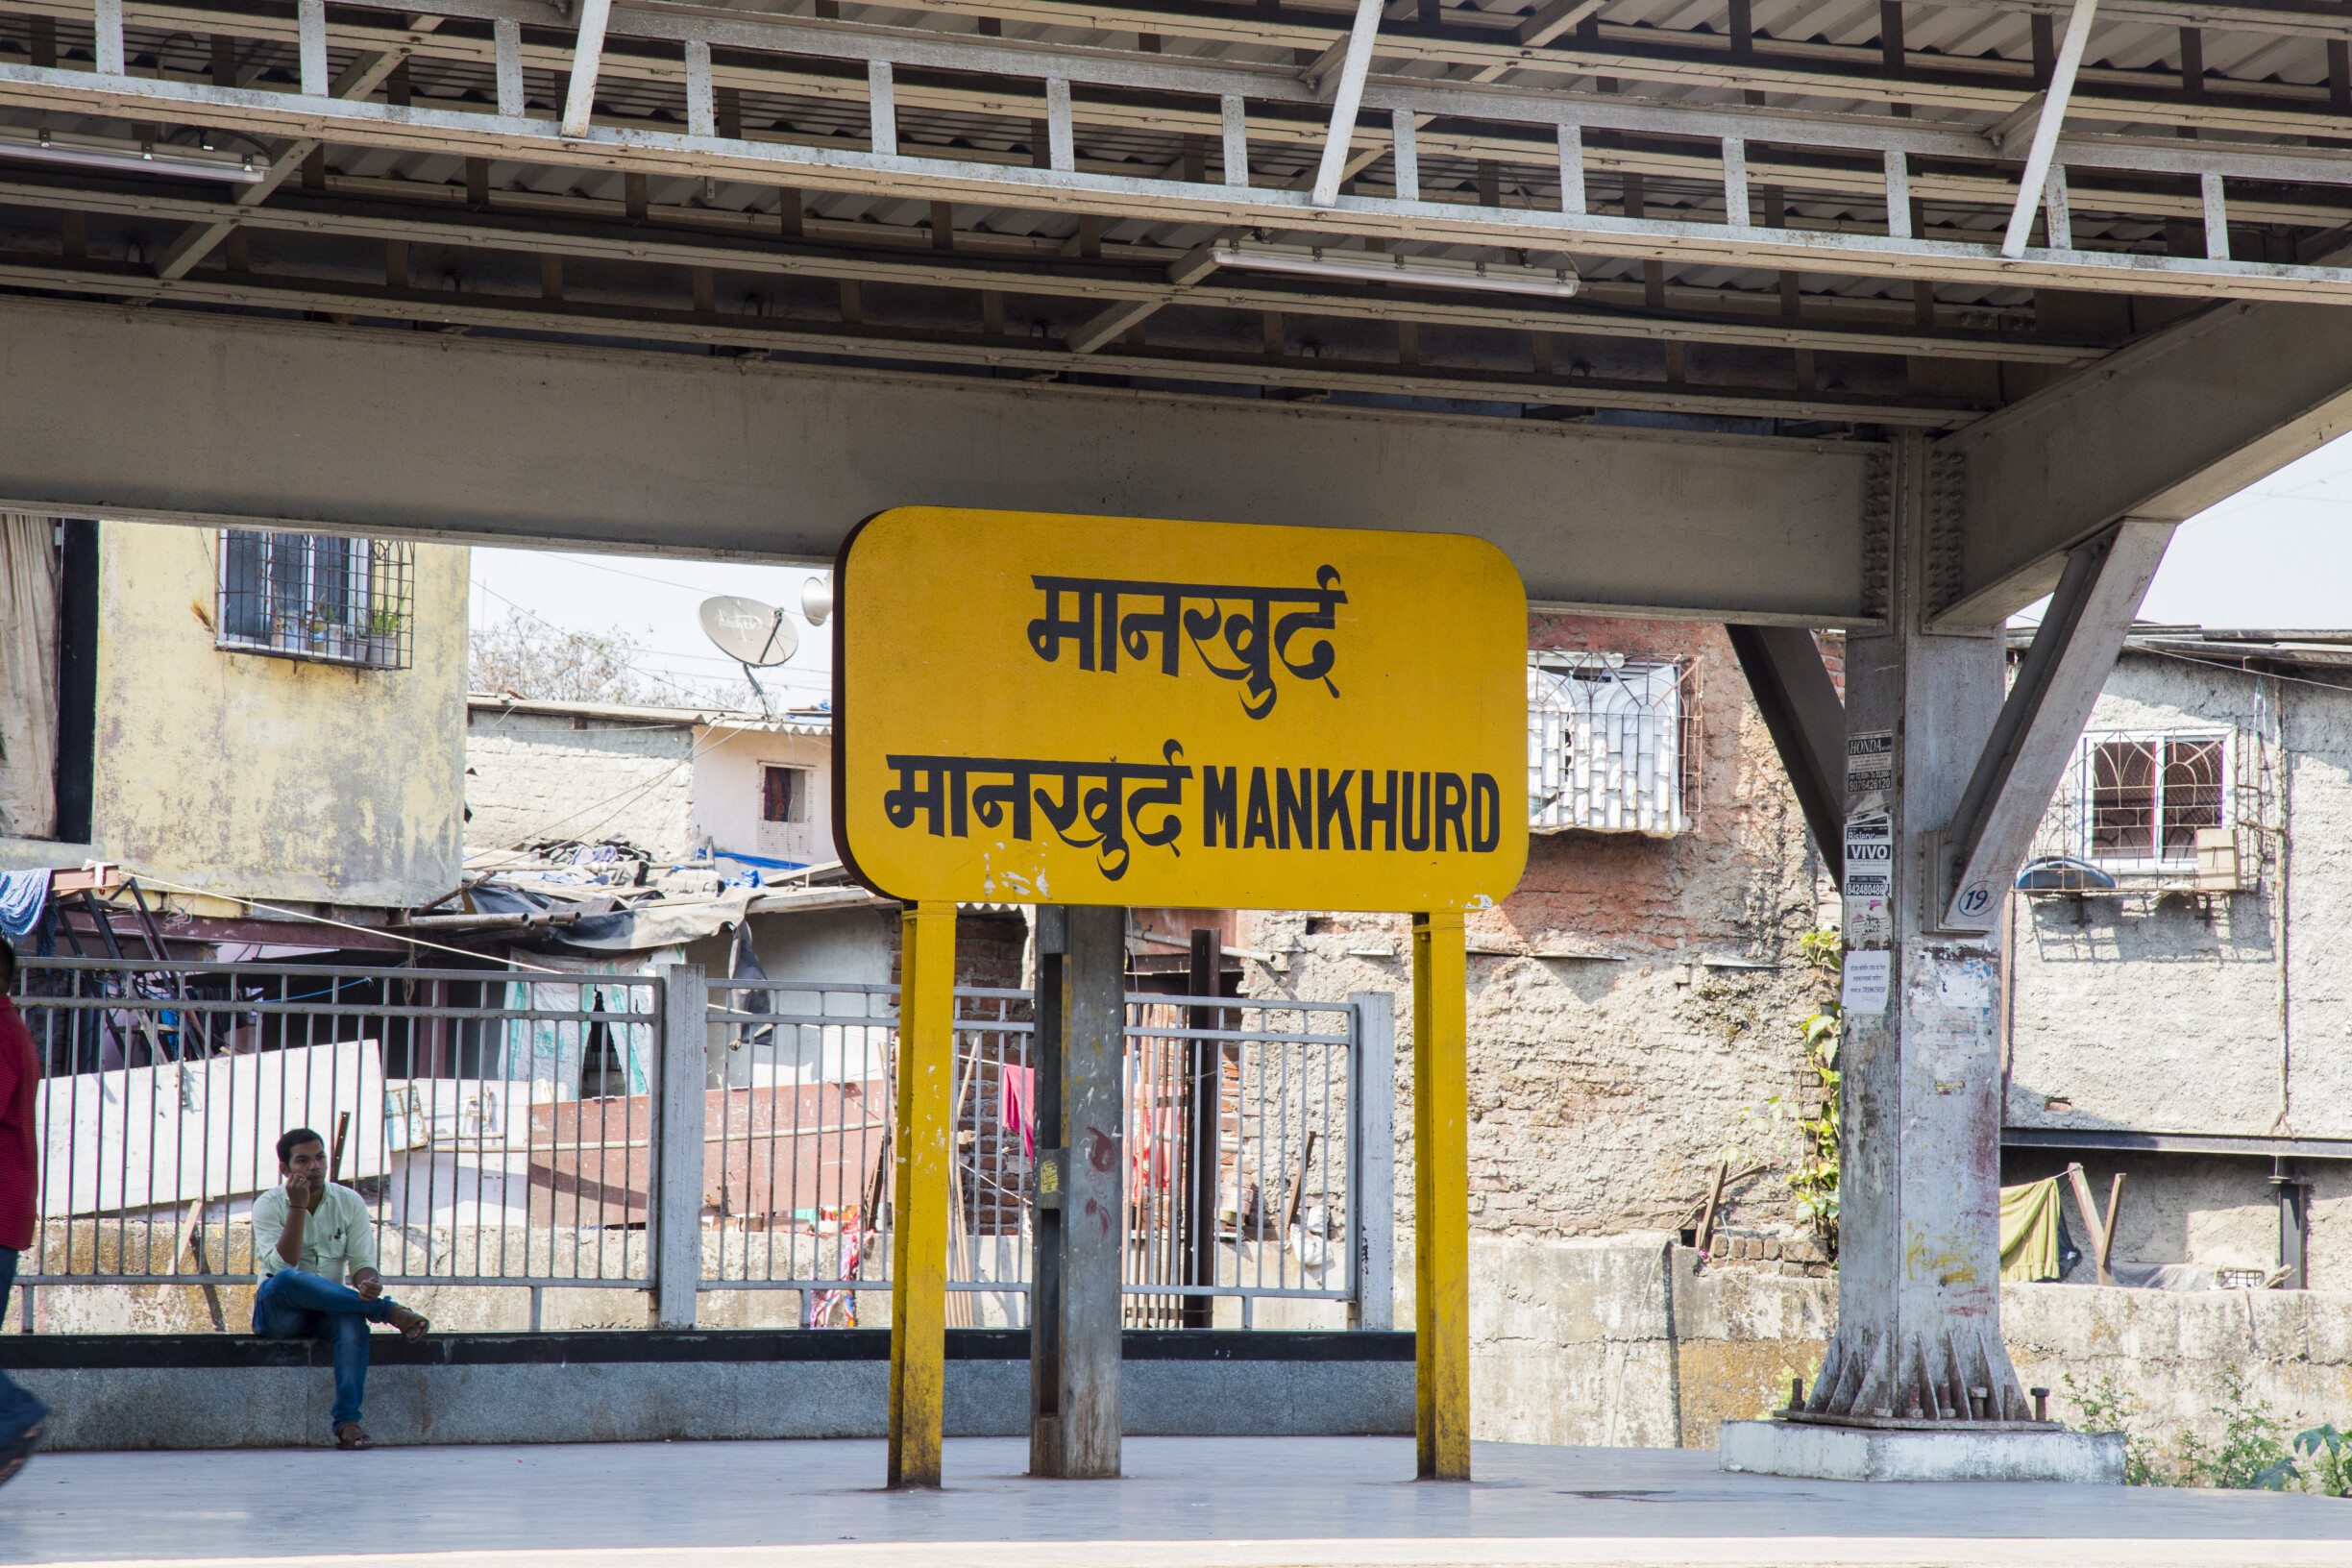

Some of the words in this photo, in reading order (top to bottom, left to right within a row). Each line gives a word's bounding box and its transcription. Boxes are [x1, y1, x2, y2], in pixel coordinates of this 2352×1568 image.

[1027, 564, 1347, 721] मानखुर्द
[1850, 739, 1881, 754] HONDA
[1850, 778, 1891, 792] 9076426120
[884, 739, 1192, 881] मानखुर्द
[1203, 766, 1501, 853] MANKHURD
[1850, 845, 1888, 859] VIVO
[1965, 890, 1989, 910] 19
